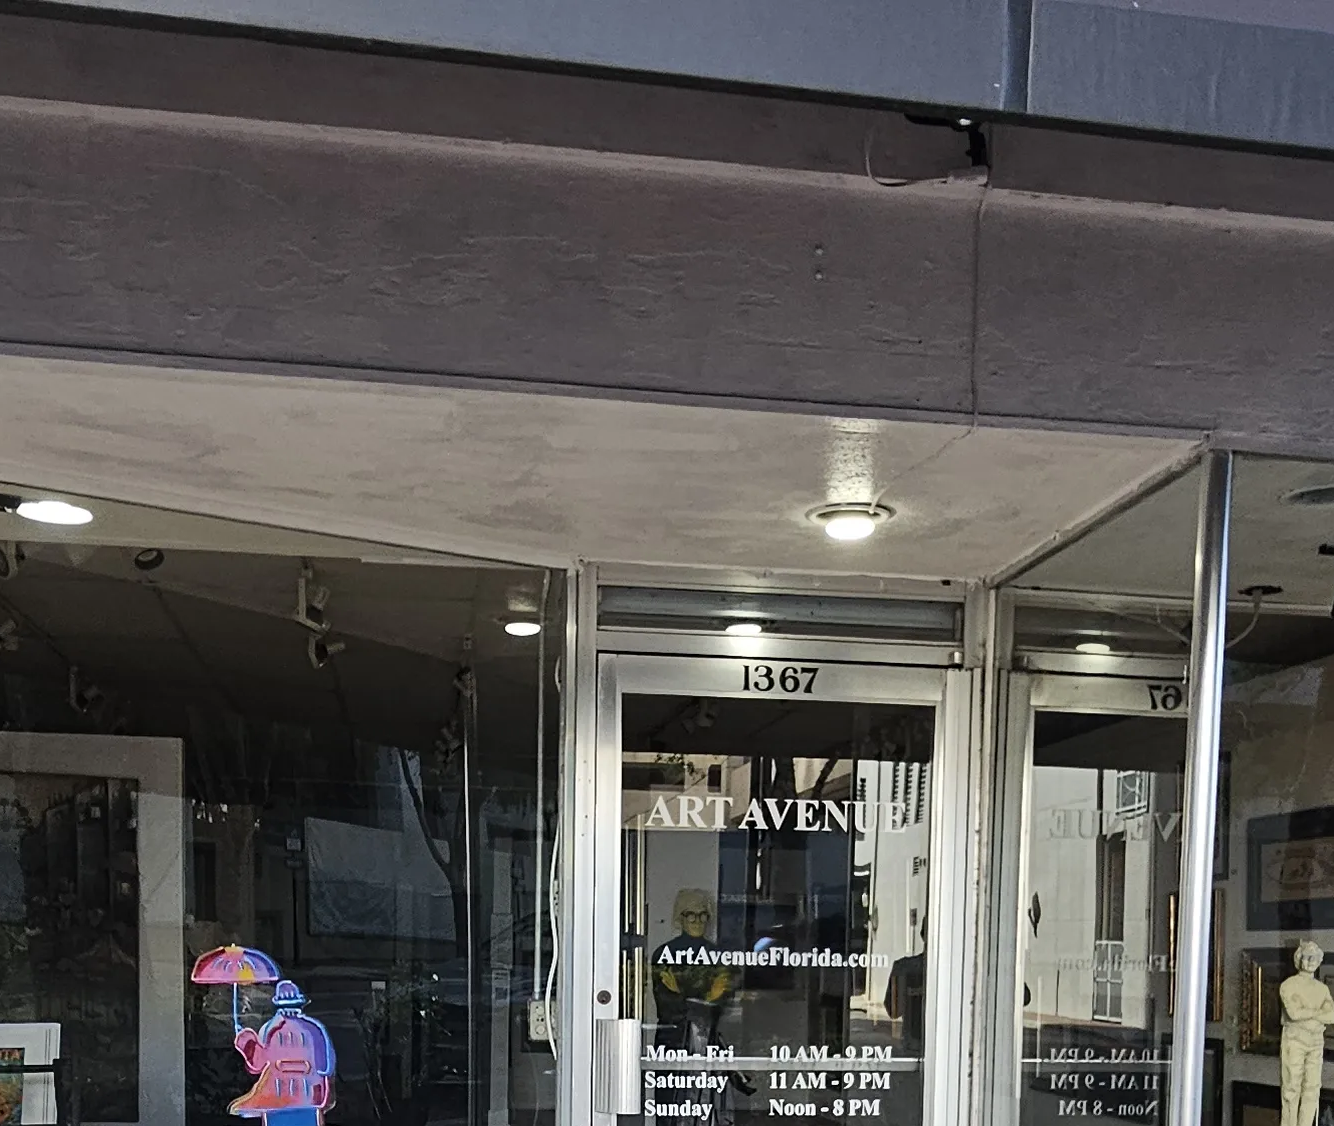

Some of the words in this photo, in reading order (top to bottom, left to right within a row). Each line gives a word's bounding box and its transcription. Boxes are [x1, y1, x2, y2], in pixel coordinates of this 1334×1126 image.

[742, 664, 819, 694] 1367
[645, 795, 733, 830] ART
[738, 798, 907, 834] AVENUE
[657, 945, 889, 968] ArtAvenueFlorida.com
[646, 1044, 688, 1063] Mon
[706, 1044, 735, 1063] Fri
[769, 1045, 791, 1063] 10
[793, 1045, 829, 1063] AM
[844, 1045, 857, 1062] 9
[860, 1045, 893, 1063] PM
[644, 1071, 729, 1094] Saturday
[769, 1071, 788, 1090] 11
[791, 1072, 827, 1090] AM
[843, 1072, 855, 1090] 9
[858, 1072, 891, 1090] PM
[644, 1099, 713, 1121] Sunday
[768, 1098, 817, 1117] Noon
[832, 1098, 845, 1117] 8
[848, 1098, 881, 1117] PM
